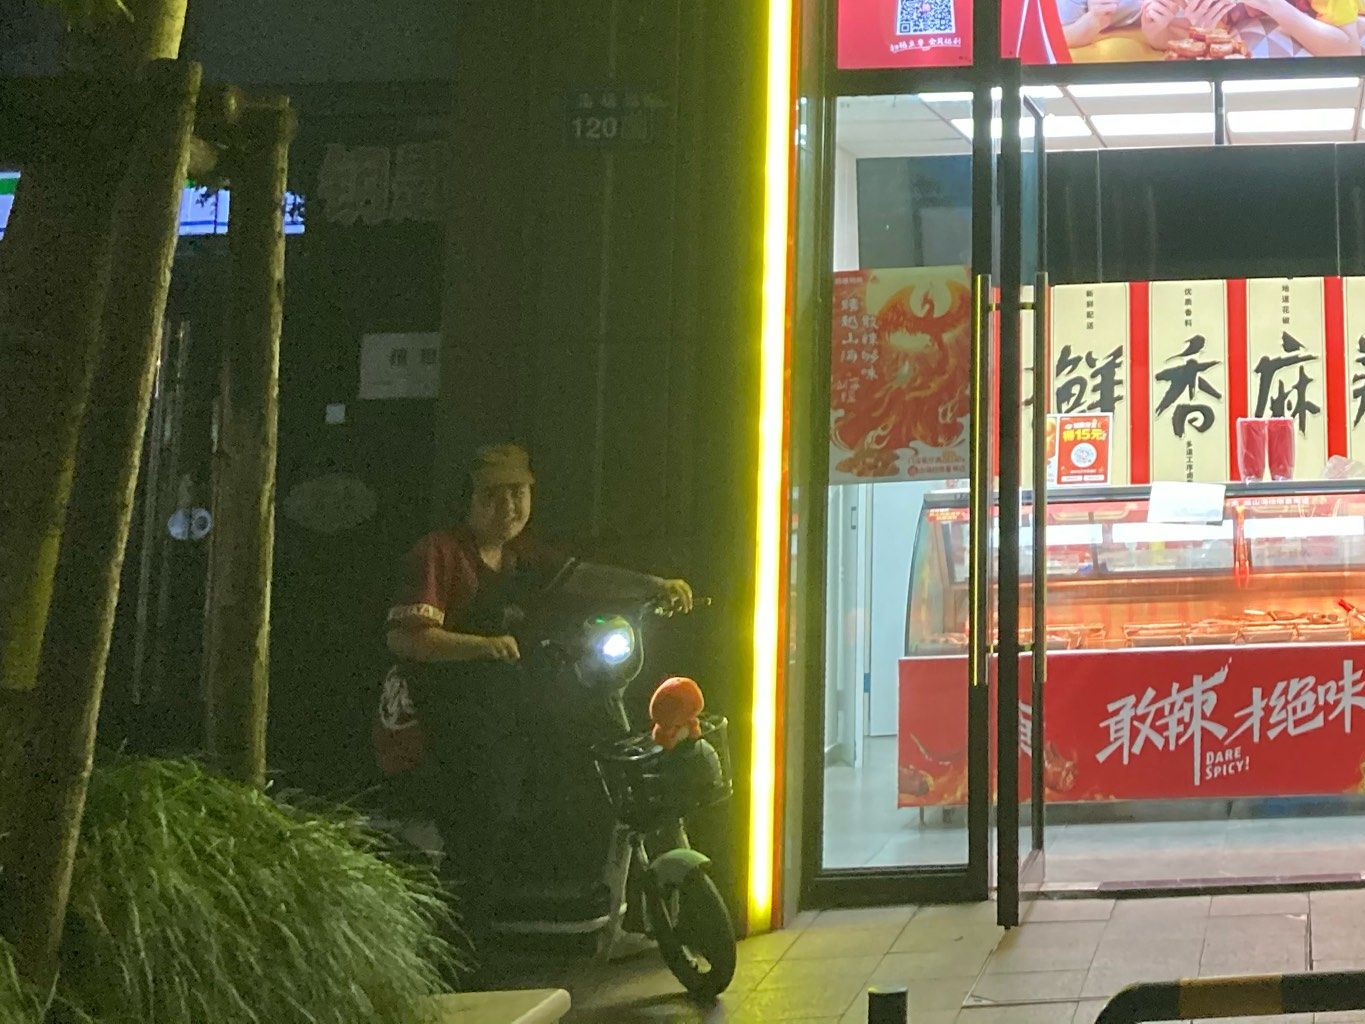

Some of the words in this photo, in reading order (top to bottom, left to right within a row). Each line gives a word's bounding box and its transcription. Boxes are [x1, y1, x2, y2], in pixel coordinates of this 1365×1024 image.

[572, 116, 618, 139] 120
[1206, 746, 1242, 765] DARE
[1205, 756, 1250, 780] SPICY!
